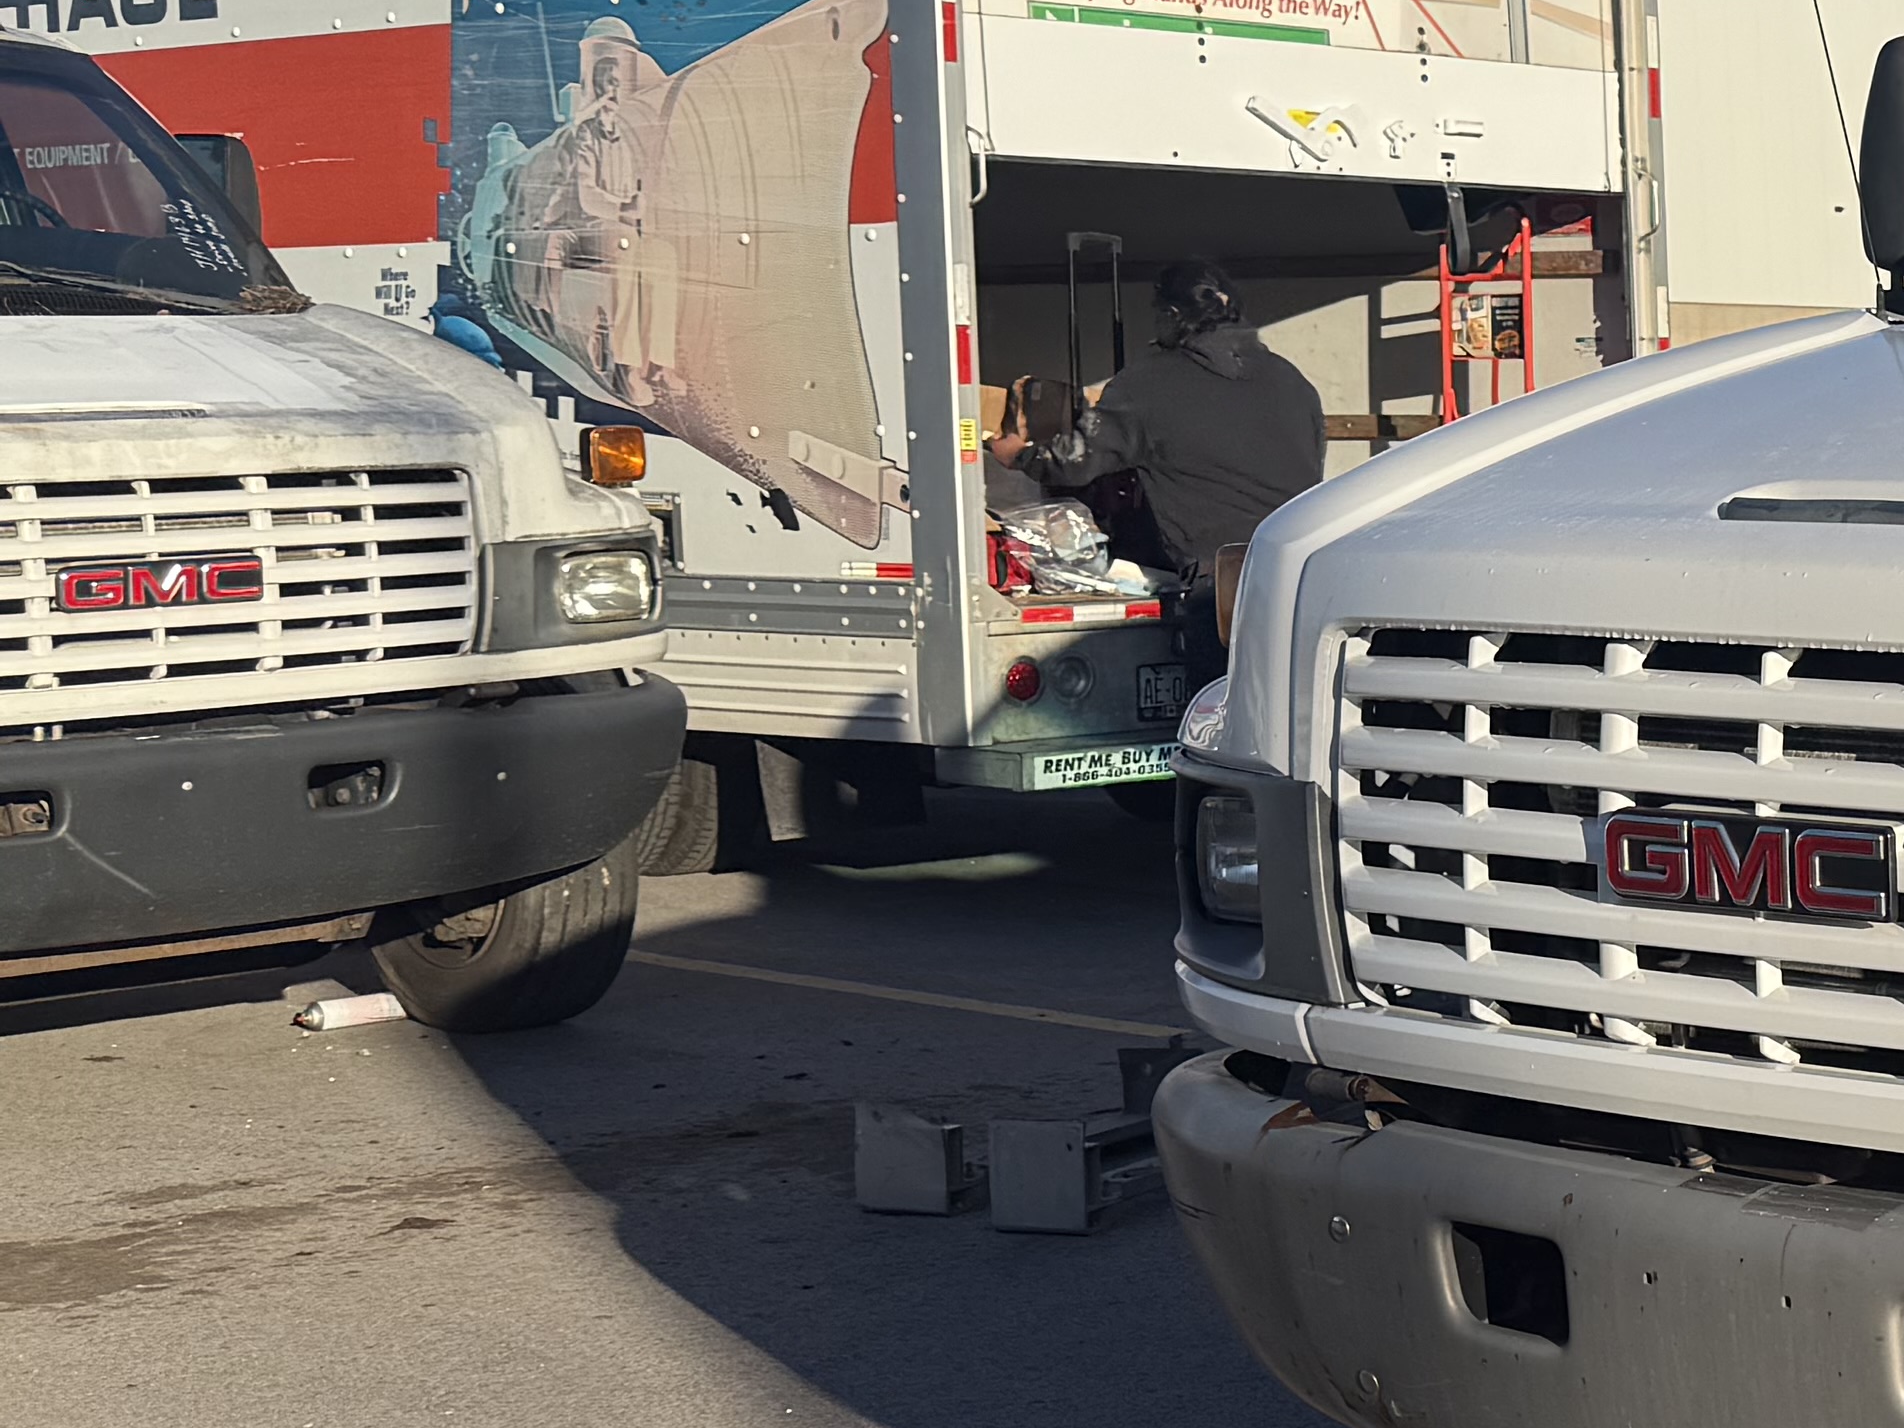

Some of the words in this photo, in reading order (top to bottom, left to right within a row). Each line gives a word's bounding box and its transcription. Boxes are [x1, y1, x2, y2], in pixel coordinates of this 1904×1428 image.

[25, 142, 111, 169] EQUIPMENT
[60, 559, 261, 609] GMC
[1043, 757, 1085, 774] RENT
[1121, 749, 1154, 765] BUY
[1605, 813, 1886, 918] GMC
